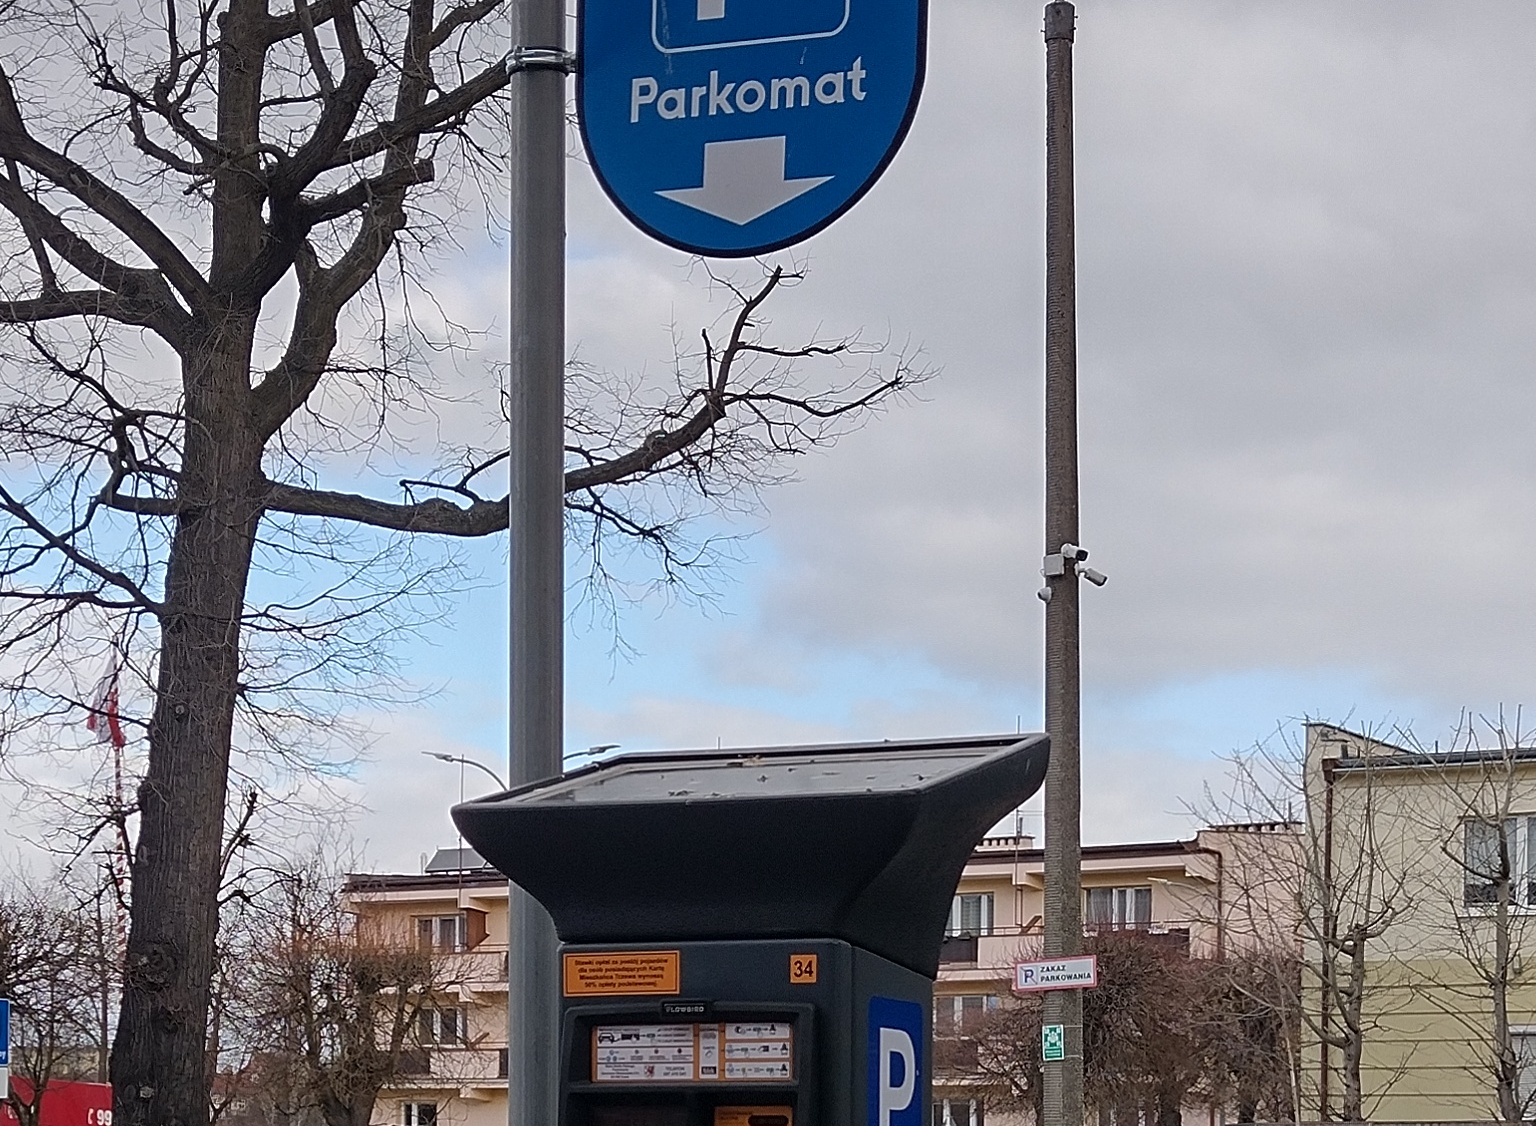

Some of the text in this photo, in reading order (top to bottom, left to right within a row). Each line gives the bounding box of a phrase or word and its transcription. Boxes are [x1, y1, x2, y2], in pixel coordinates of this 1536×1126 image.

[630, 56, 867, 123] Parkomat
[793, 960, 814, 978] 34
[1040, 965, 1066, 973] ZAKAZ
[1041, 972, 1091, 982] PARKOWANIA
